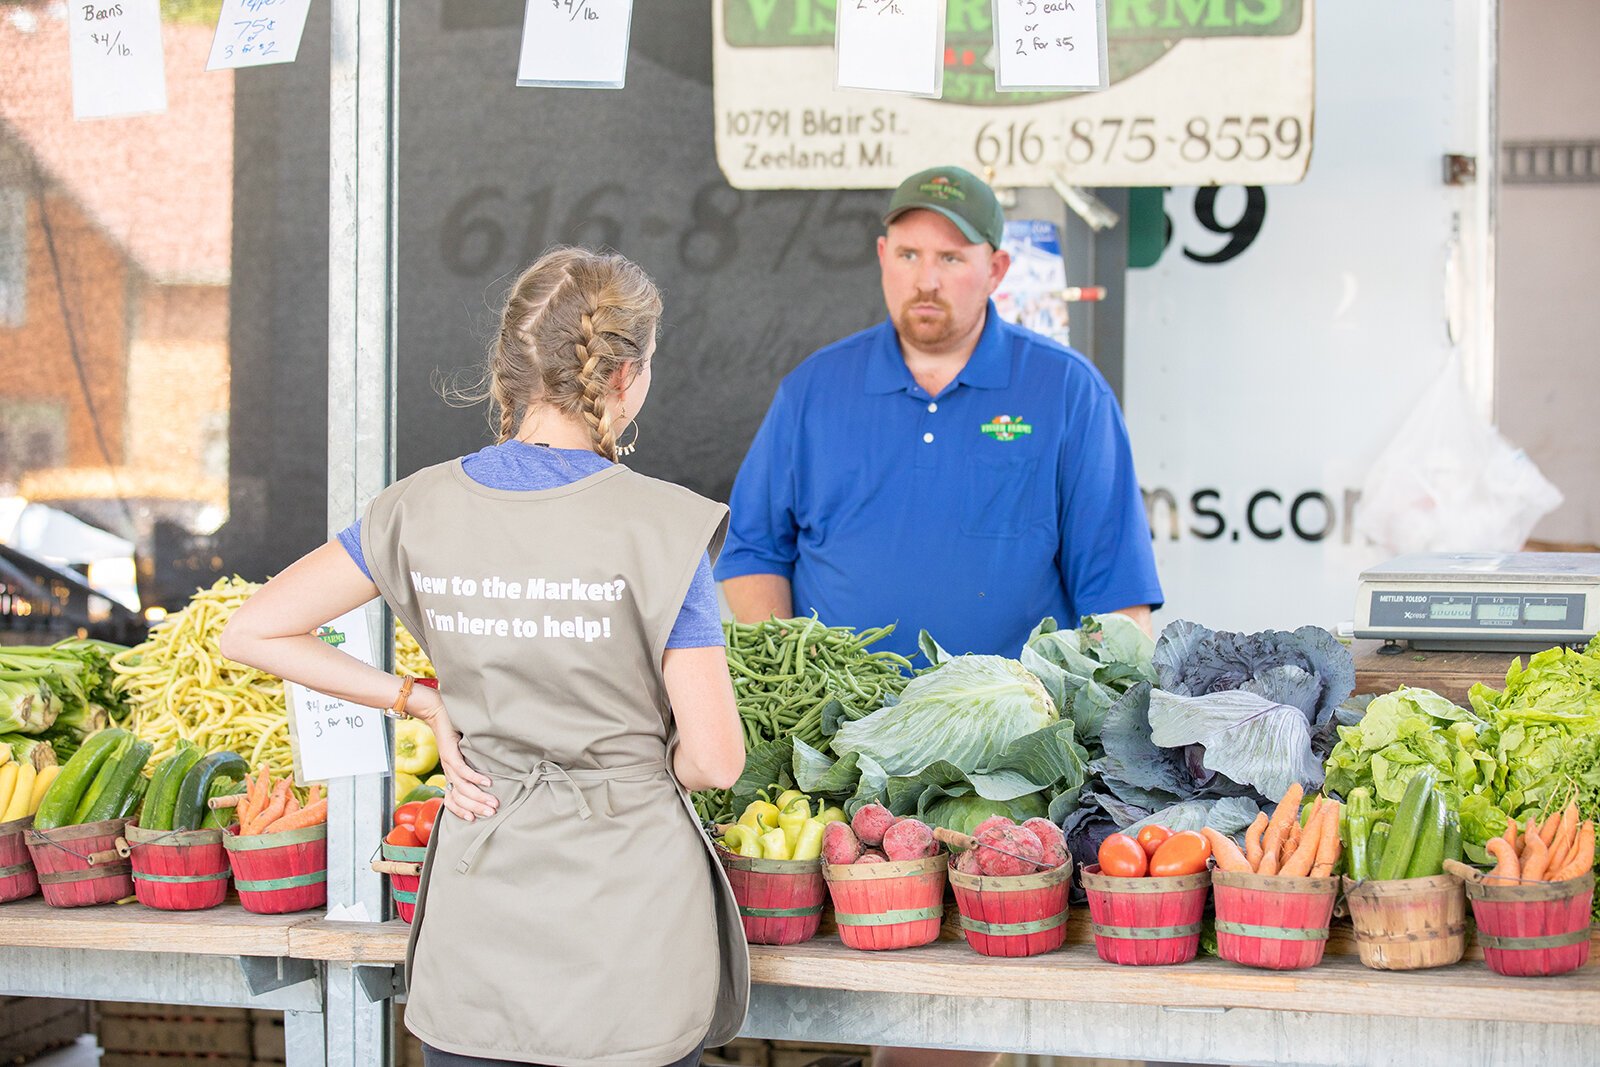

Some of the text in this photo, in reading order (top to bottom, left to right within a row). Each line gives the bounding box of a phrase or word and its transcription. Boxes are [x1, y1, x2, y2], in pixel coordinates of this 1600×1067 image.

[82, 4, 123, 21] Beans
[1043, 0, 1075, 14] each
[1024, 23, 1039, 32] or
[90, 30, 133, 56] $4/lb.
[225, 44, 234, 59] 3
[1016, 36, 1075, 56] 2 for $5
[726, 109, 790, 137] 10791
[802, 107, 864, 135] Blair
[973, 115, 1302, 166] 616-875-8559
[411, 571, 626, 601] New to the Market?
[1380, 595, 1404, 603] METTLER
[426, 609, 611, 643] I'm here to help!
[324, 700, 344, 711] each
[313, 715, 364, 737] 3 for $10
